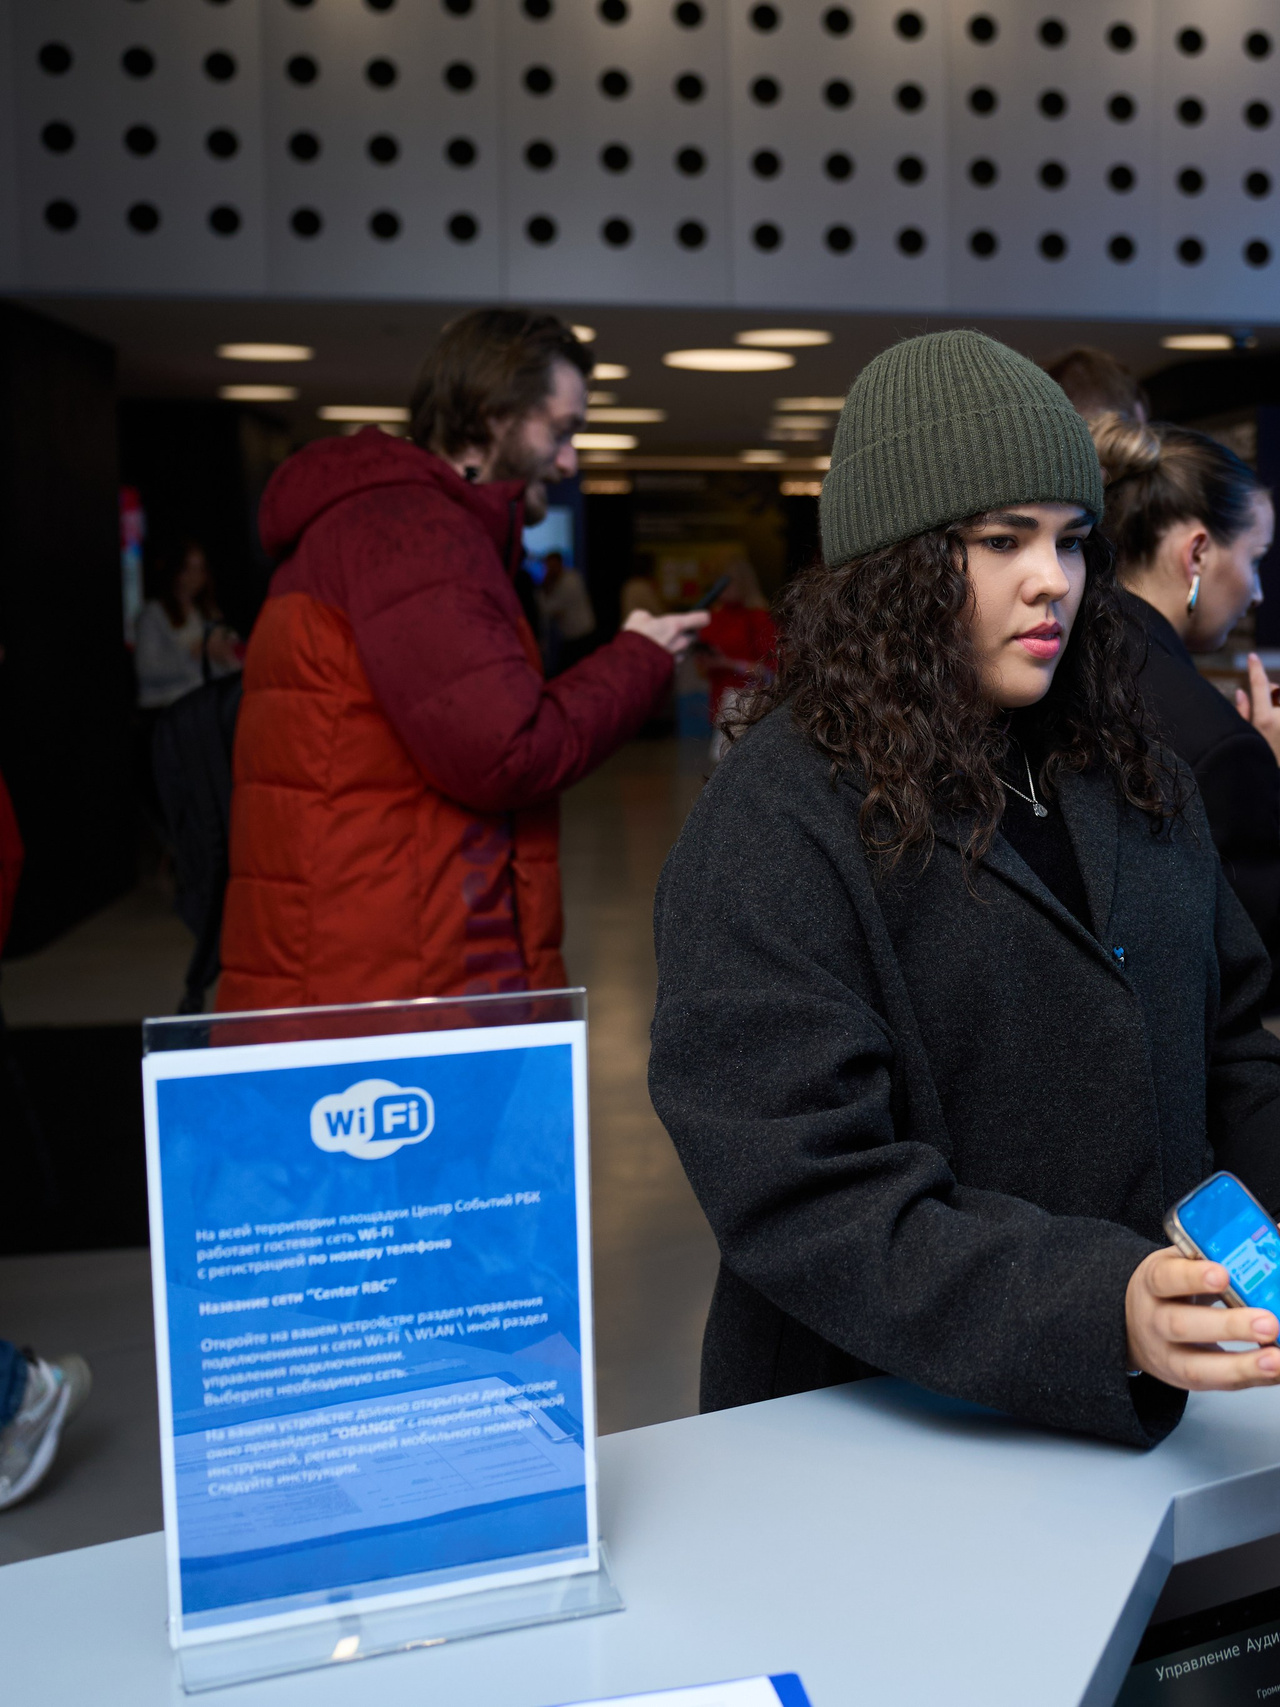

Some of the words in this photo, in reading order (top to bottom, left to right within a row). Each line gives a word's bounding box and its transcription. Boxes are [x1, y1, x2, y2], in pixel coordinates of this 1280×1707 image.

[196, 1229, 215, 1242] На
[218, 1223, 252, 1240] всей
[255, 1217, 336, 1236] территории
[339, 1208, 409, 1225] площадки
[412, 1202, 452, 1219] Центр
[454, 1194, 513, 1212] Событий
[515, 1190, 541, 1205] РБК
[197, 1243, 260, 1263] работает
[264, 1236, 323, 1253] гостевая
[326, 1232, 356, 1245] сеть
[357, 1225, 394, 1241] Wi-Fi
[197, 1268, 206, 1279] с
[208, 1253, 306, 1280] регистрацией
[308, 1254, 328, 1266] по
[329, 1247, 384, 1262] номеру
[386, 1238, 452, 1255] телефона
[199, 1297, 270, 1316] Название
[272, 1292, 304, 1306] сети
[200, 1332, 268, 1352] Откройте
[271, 1331, 289, 1343] на
[291, 1323, 338, 1340] вашем
[340, 1314, 415, 1336] устройстве
[417, 1307, 464, 1325] раздел
[465, 1296, 543, 1318] управления
[201, 1343, 319, 1371] подключениями
[320, 1343, 330, 1354] к
[331, 1338, 362, 1353] сети
[363, 1331, 400, 1347] Wi-Fi
[414, 1324, 455, 1341] WLAN
[466, 1317, 500, 1333] иной
[502, 1313, 548, 1330] раздел
[202, 1367, 287, 1390] управления
[203, 1387, 274, 1407] Выберите
[276, 1371, 373, 1396] необходимую
[205, 1430, 225, 1442] На
[228, 1423, 276, 1439] вашем
[278, 1411, 354, 1433] устройстве
[356, 1403, 409, 1421] должно
[411, 1391, 479, 1411] открыться
[481, 1380, 557, 1400] диалоговое
[206, 1445, 242, 1460] окно
[244, 1431, 329, 1455] провайдера
[417, 1404, 491, 1427] подробной
[304, 1437, 399, 1464] регистрацией
[401, 1425, 481, 1447] мобильного
[208, 1476, 274, 1496] Следуйте
[1155, 1643, 1240, 1681] Управление
